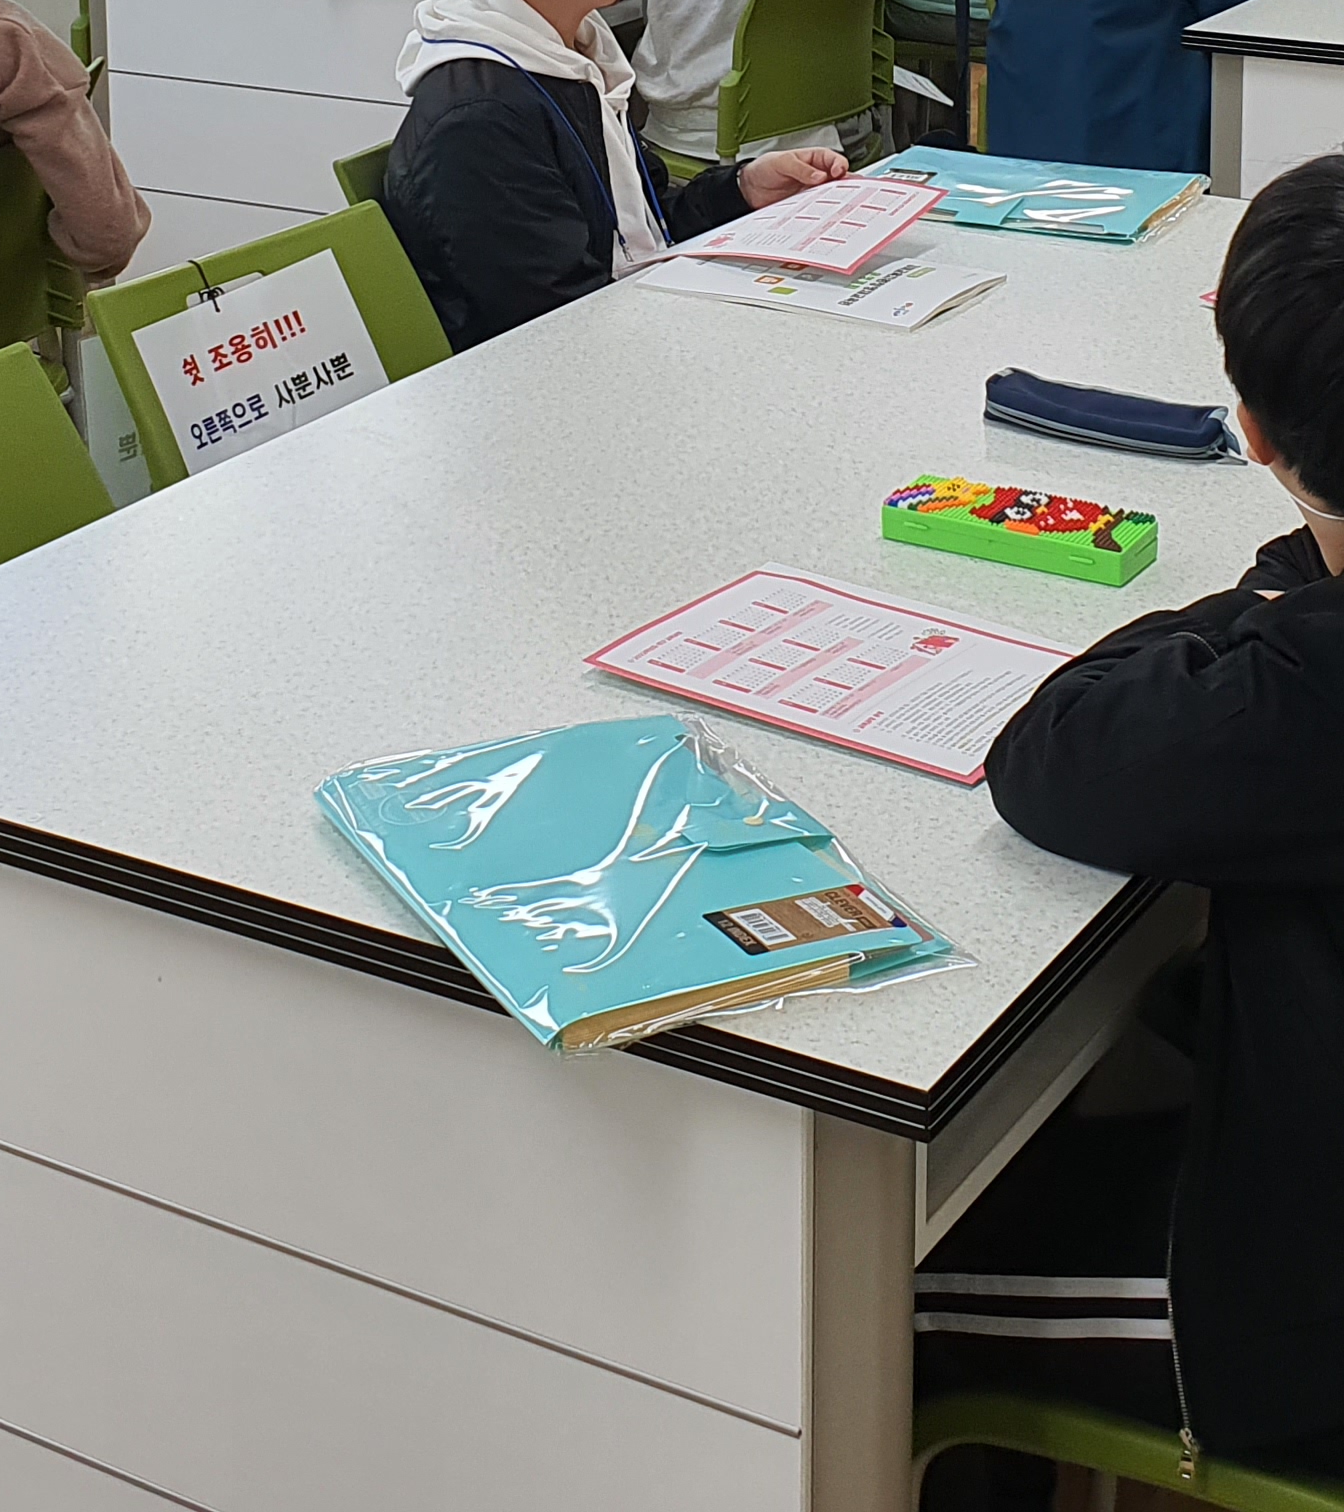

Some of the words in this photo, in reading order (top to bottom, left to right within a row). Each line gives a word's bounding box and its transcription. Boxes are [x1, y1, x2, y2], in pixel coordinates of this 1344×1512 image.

[182, 354, 205, 387] 쉿
[207, 310, 307, 372] 조용히!!!
[190, 393, 269, 450] 오른쪽으로
[274, 352, 355, 409] 사뿐사뿐
